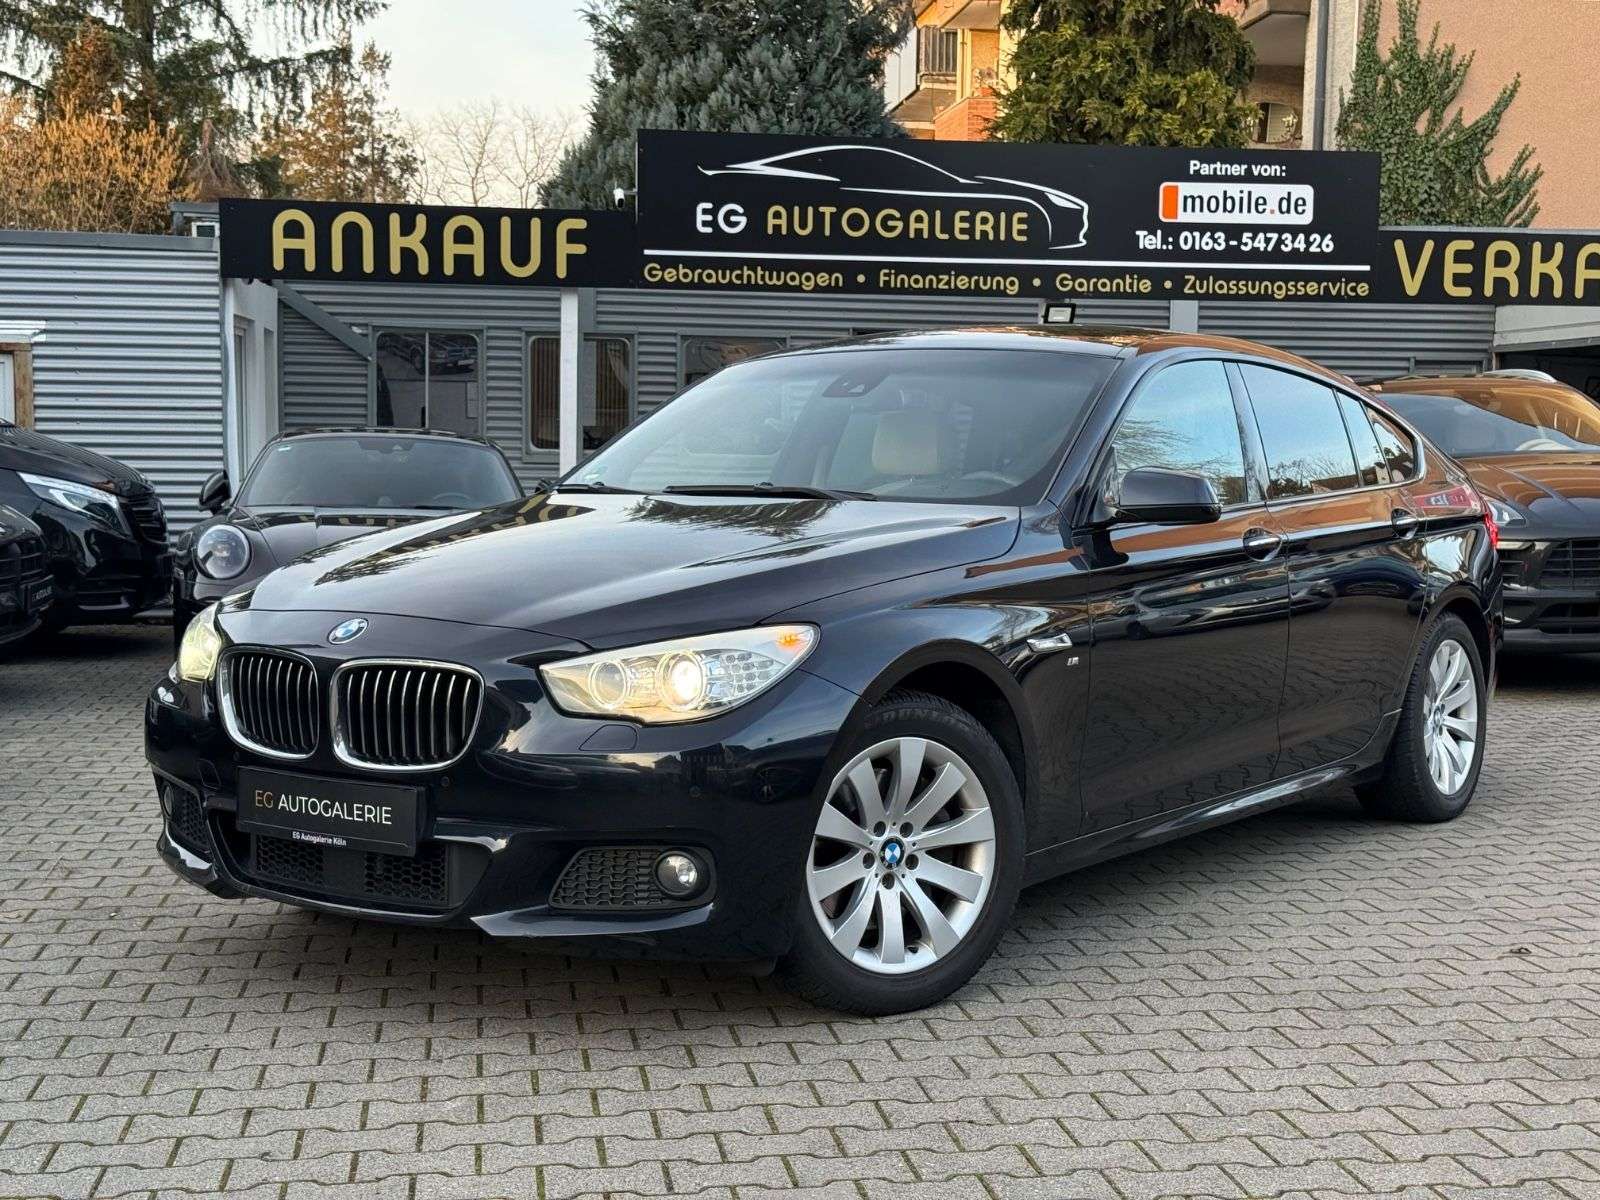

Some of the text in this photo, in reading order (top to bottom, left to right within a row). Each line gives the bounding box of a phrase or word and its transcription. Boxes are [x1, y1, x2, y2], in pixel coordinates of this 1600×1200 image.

[1189, 160, 1287, 177] Partner von:
[1181, 190, 1307, 216] mobile.de
[696, 202, 1029, 241] EG AUTOGALERIE
[272, 208, 587, 279] ANKAUF
[1136, 230, 1173, 251] Tel.:
[644, 262, 1370, 300] Gebrauchtwagen Finanzierung Garantie Zulassungsservice
[255, 789, 393, 825] EG AUTOGALERIE
[292, 831, 347, 847] EG Autogalerie Köln
